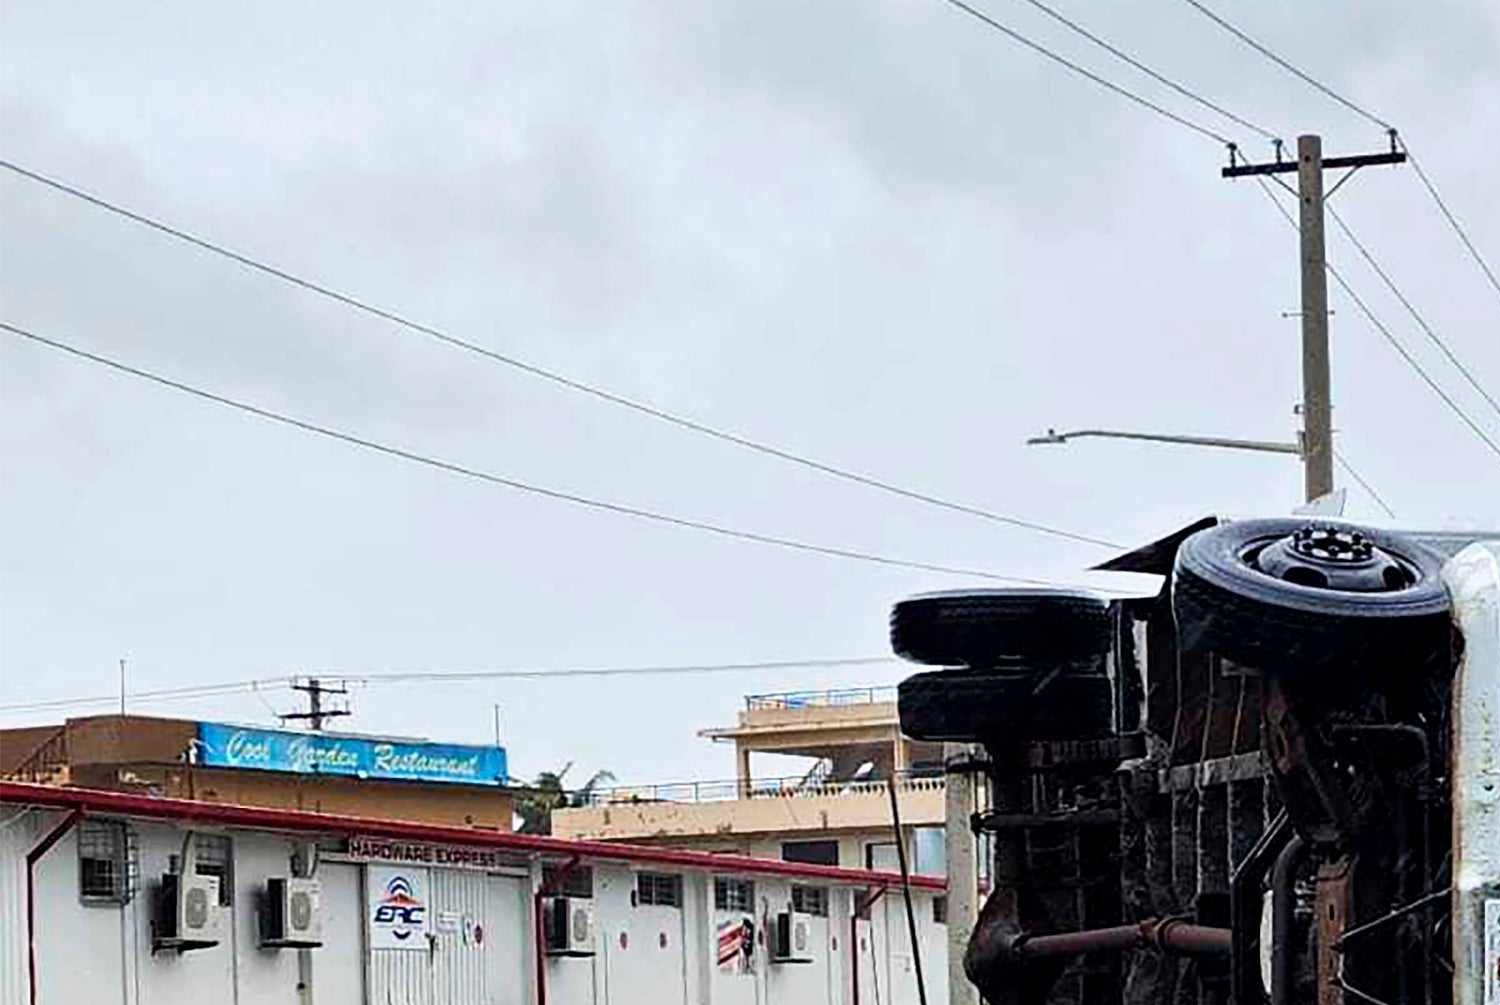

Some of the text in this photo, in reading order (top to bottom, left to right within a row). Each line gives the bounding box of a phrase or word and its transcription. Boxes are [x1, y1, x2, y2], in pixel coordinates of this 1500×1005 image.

[374, 743, 480, 776] Restaurant
[350, 841, 496, 867] HARDWARE EXPRESS
